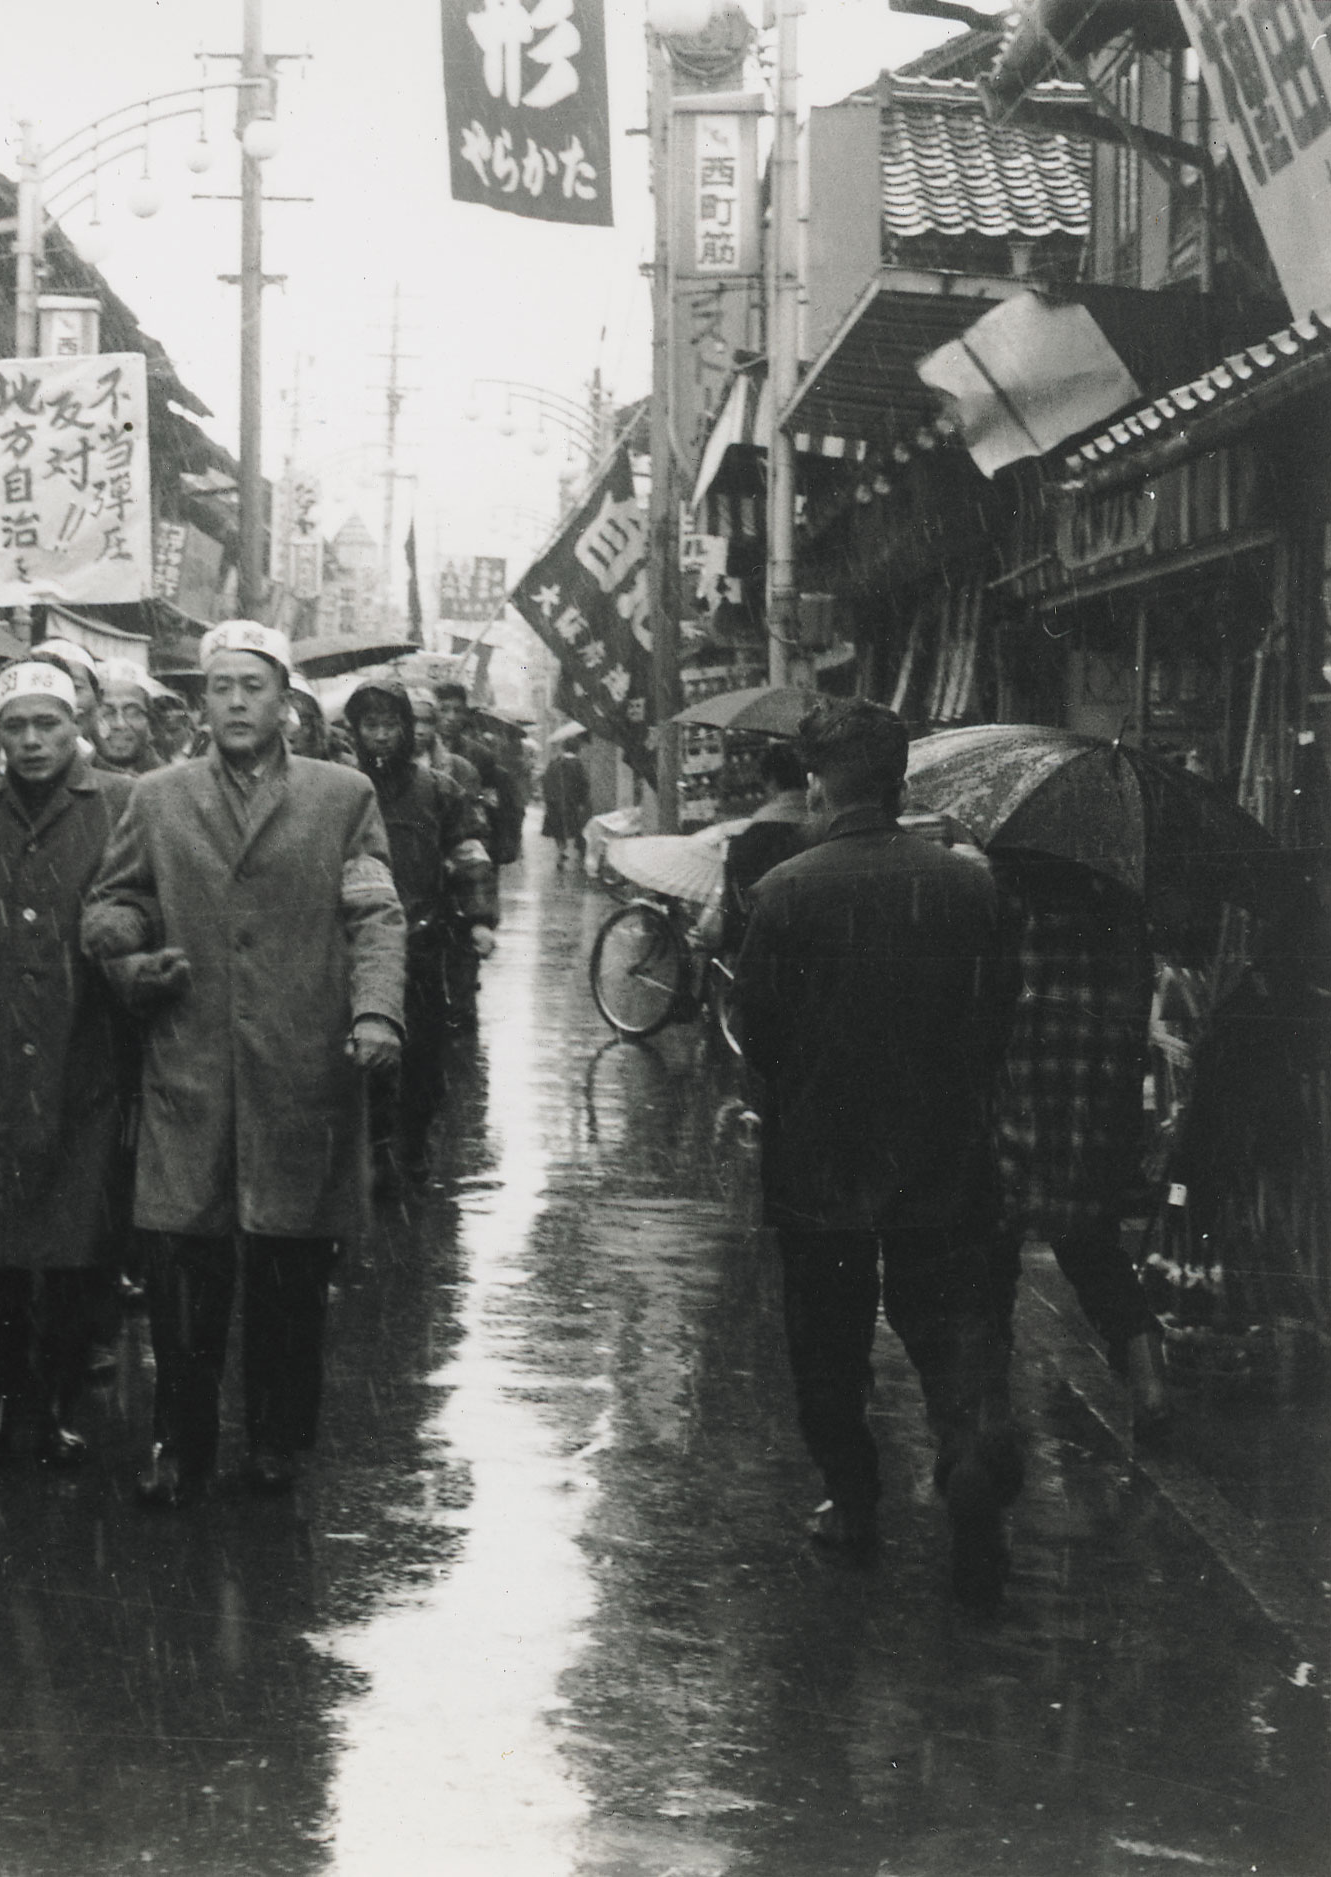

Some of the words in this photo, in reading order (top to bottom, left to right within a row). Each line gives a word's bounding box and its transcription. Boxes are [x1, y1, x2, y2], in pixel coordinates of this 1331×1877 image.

[461, 120, 597, 200] やらかた
[701, 156, 735, 265] 西町筋
